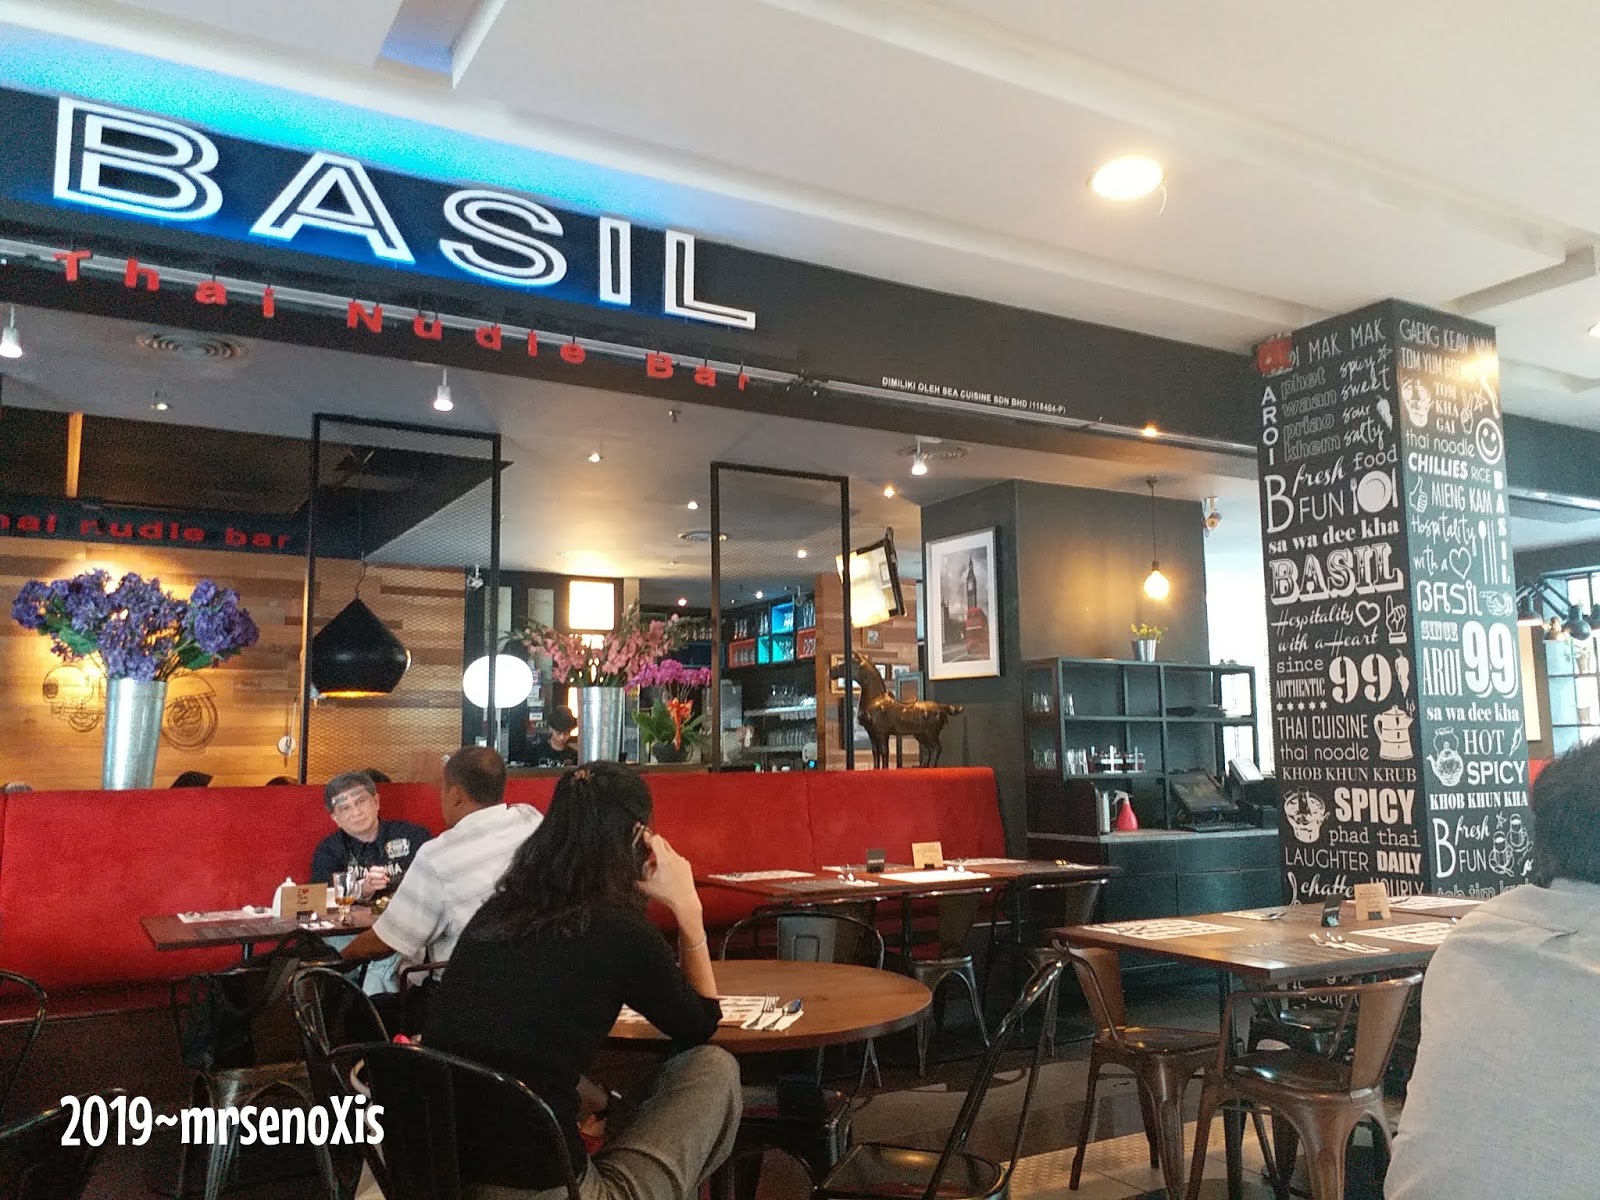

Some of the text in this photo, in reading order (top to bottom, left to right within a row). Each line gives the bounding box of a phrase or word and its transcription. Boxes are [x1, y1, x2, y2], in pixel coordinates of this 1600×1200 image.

[53, 97, 757, 330] BASIL
[54, 250, 275, 318] Thai
[646, 352, 751, 391] Bar
[1400, 318, 1440, 348] GAENG
[1308, 333, 1342, 363] MAK
[1350, 318, 1386, 350] MAK
[1400, 347, 1421, 370] TOM
[1422, 352, 1442, 376] YUM
[882, 376, 916, 392] DIMILIKI
[917, 382, 940, 394] OLEH
[942, 386, 959, 397] SEA
[960, 389, 992, 402] CUISINE
[993, 395, 1010, 405] SDN
[1011, 397, 1028, 408] BHD
[1281, 355, 1377, 400] phet spicy
[1281, 364, 1391, 418] waan sweet
[1433, 381, 1456, 400] TOM
[1283, 405, 1371, 444] priao sour
[1435, 400, 1460, 418] KHA
[1261, 386, 1279, 467] AROI
[1284, 417, 1384, 462] khem salty
[1436, 418, 1456, 433] GAI
[1406, 428, 1476, 458] thai noodle
[1408, 452, 1491, 483] CHILLIES RICE
[1264, 443, 1398, 534] B fresh food
[1431, 481, 1493, 514] MIENG KAM
[1299, 489, 1345, 525] FUN
[225, 527, 290, 548] bar
[1268, 517, 1400, 554] sa wa dee kha
[1411, 511, 1477, 557] Hospitality
[1493, 470, 1511, 584] BASIL
[1269, 542, 1405, 605] BASIL
[1441, 558, 1449, 572] a
[1271, 602, 1354, 636] Hospitality
[1278, 625, 1378, 656] with a Heart
[1276, 656, 1324, 674] since
[1422, 647, 1463, 697] AROI
[1462, 620, 1519, 699] 99
[1276, 677, 1326, 698] AUTHENTIC
[1328, 653, 1393, 704] 99
[1277, 714, 1369, 740] THAI CUISINE
[1426, 701, 1519, 722] sa wa dee kha
[1280, 742, 1370, 761] thai noodle
[1463, 729, 1505, 756] HOT
[1282, 766, 1417, 783] KHOB KHUN KRUB
[1466, 760, 1526, 785] SPICY
[1334, 787, 1415, 825] SPICY
[1429, 791, 1529, 810] KHOB KHUN KHA
[1329, 825, 1421, 847] phad thai
[1432, 815, 1490, 879] B fresh
[1284, 847, 1422, 875] LAUGHTER DAILY
[1459, 848, 1487, 873] FUN
